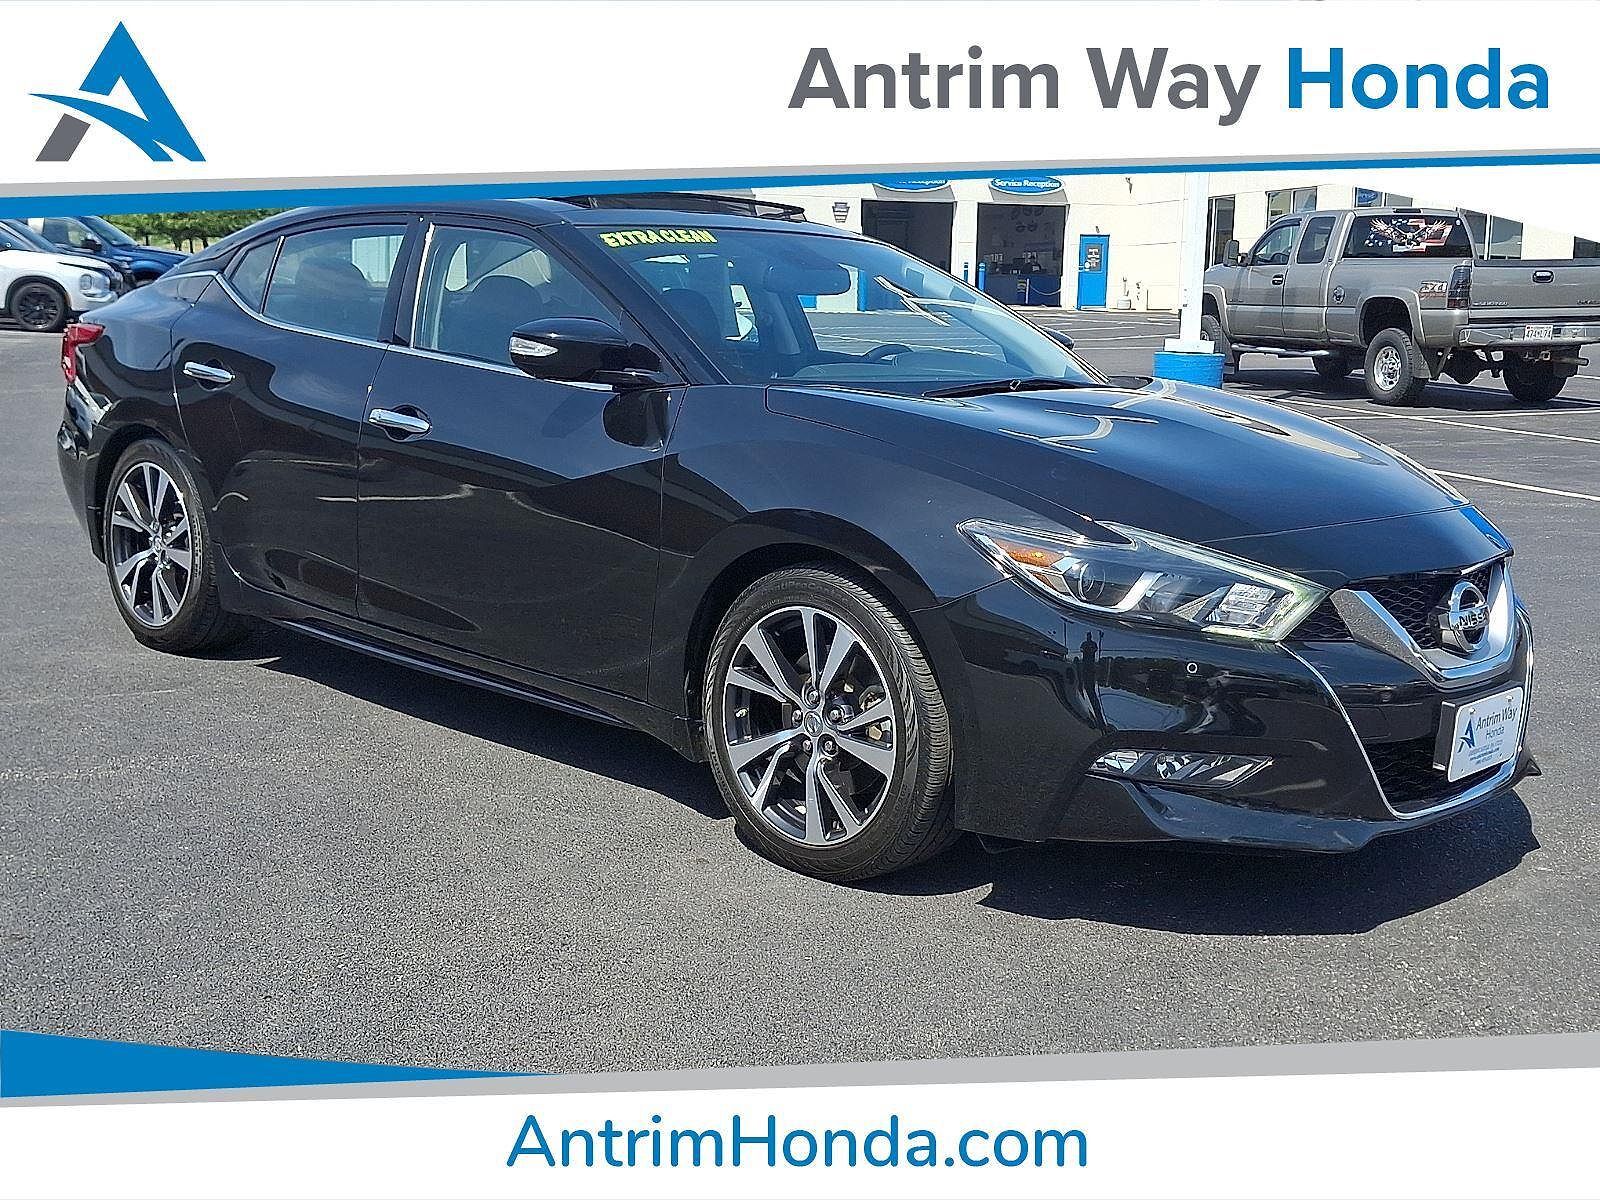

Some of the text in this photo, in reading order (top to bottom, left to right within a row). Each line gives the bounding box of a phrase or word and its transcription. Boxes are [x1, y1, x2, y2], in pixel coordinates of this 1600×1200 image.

[994, 177, 1060, 189] Service Reception
[599, 229, 718, 248] EXTRA CLEAN
[1476, 706, 1518, 731] Antrim Way
